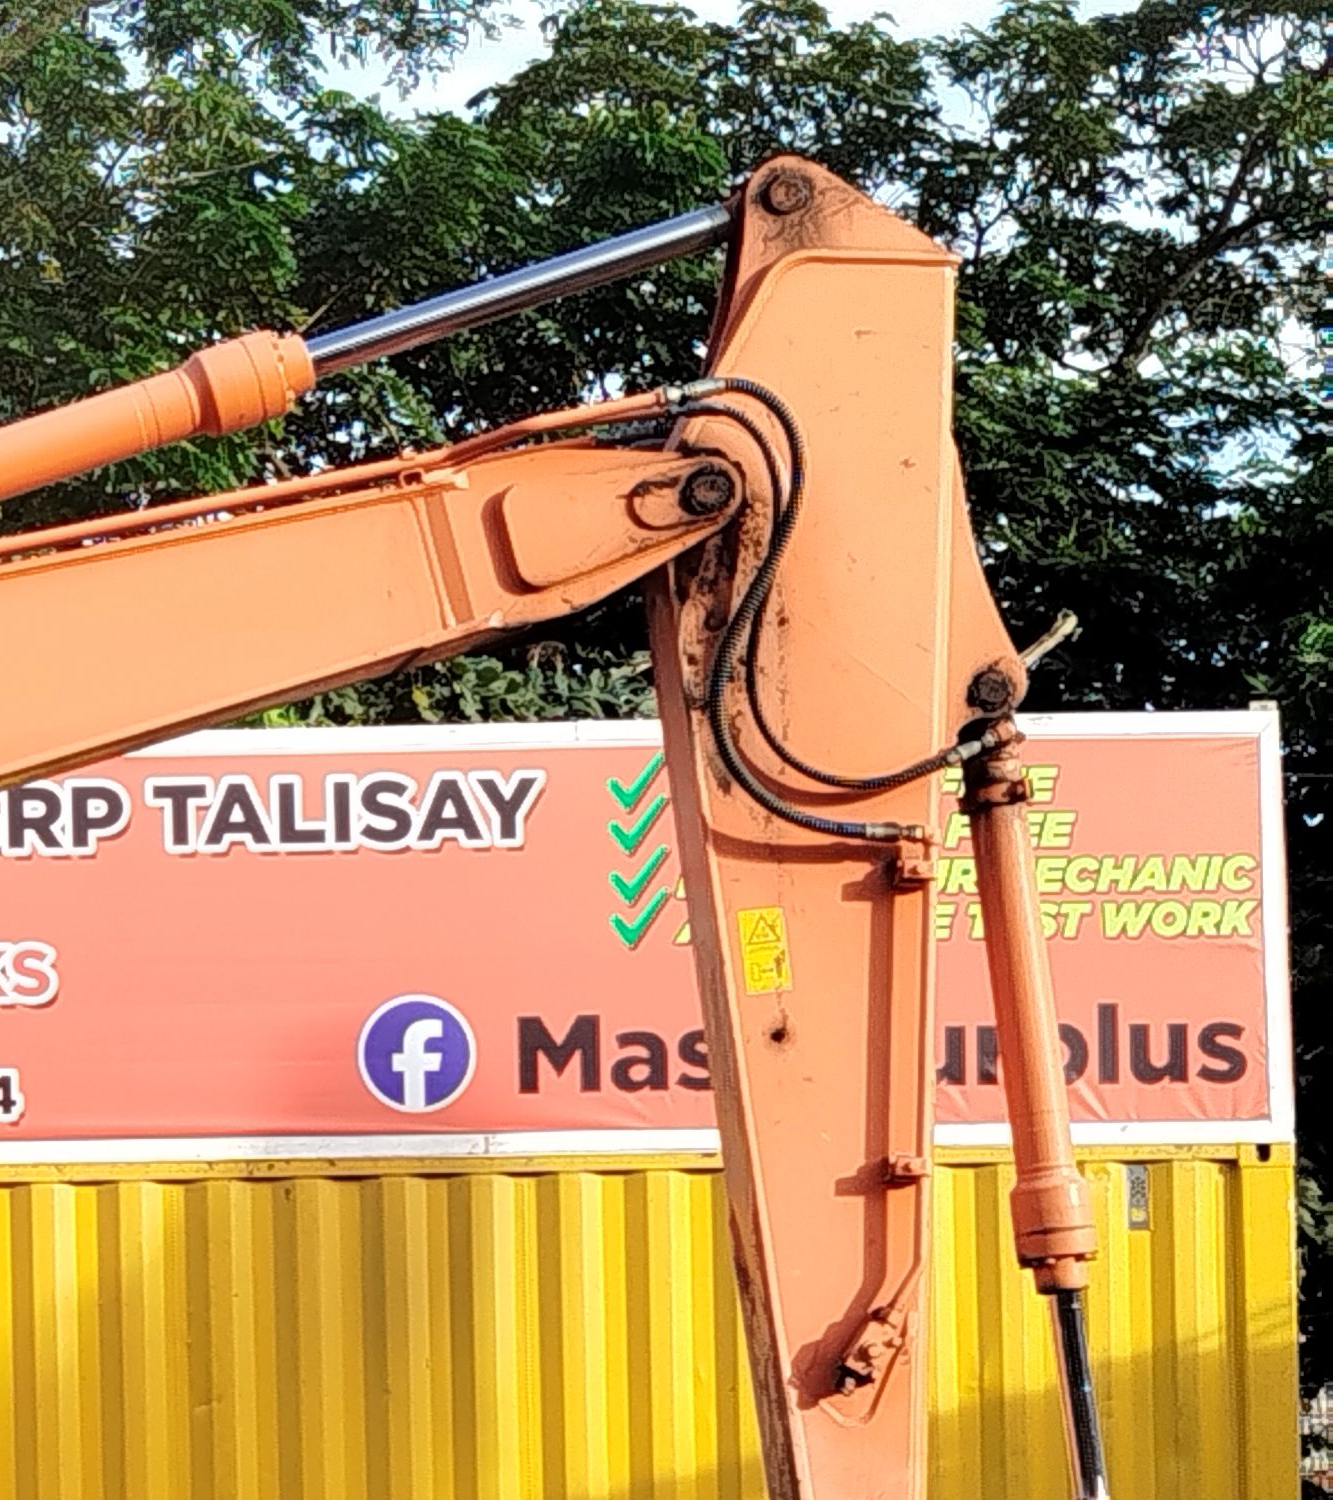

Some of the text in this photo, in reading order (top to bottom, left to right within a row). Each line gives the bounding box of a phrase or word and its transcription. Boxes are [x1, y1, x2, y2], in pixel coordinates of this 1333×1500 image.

[150, 774, 538, 849] TALISAY
[1036, 853, 1257, 893] ECHANIC
[1102, 900, 1259, 938] WORK
